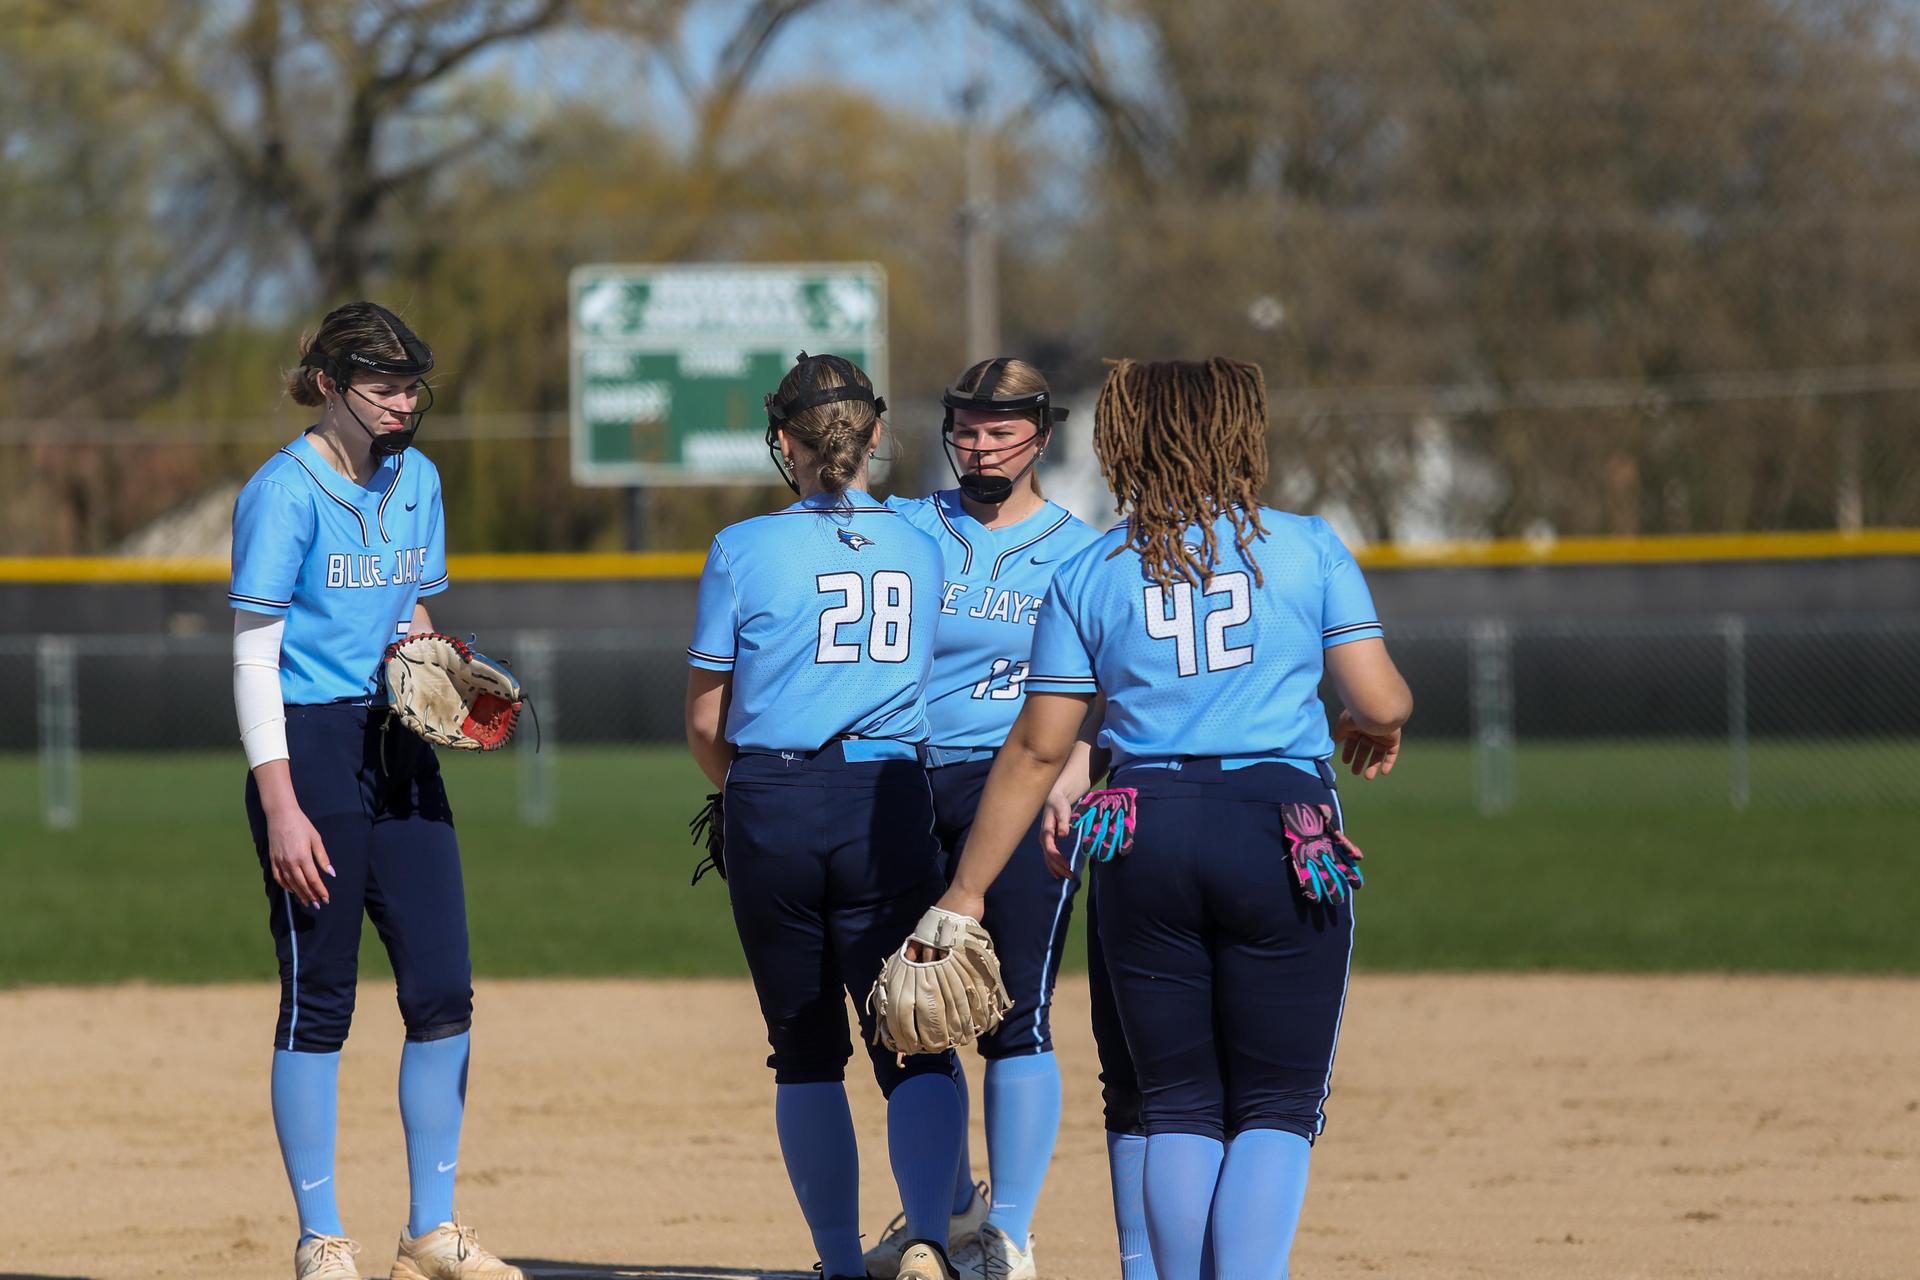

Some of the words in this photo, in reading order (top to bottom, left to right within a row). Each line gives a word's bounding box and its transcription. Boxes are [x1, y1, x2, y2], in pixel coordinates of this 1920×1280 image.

[326, 554, 387, 588] BLUE
[815, 570, 912, 664] 28
[969, 586, 1043, 625] JAYS
[1143, 570, 1254, 678] 42
[971, 658, 1030, 700] 13
